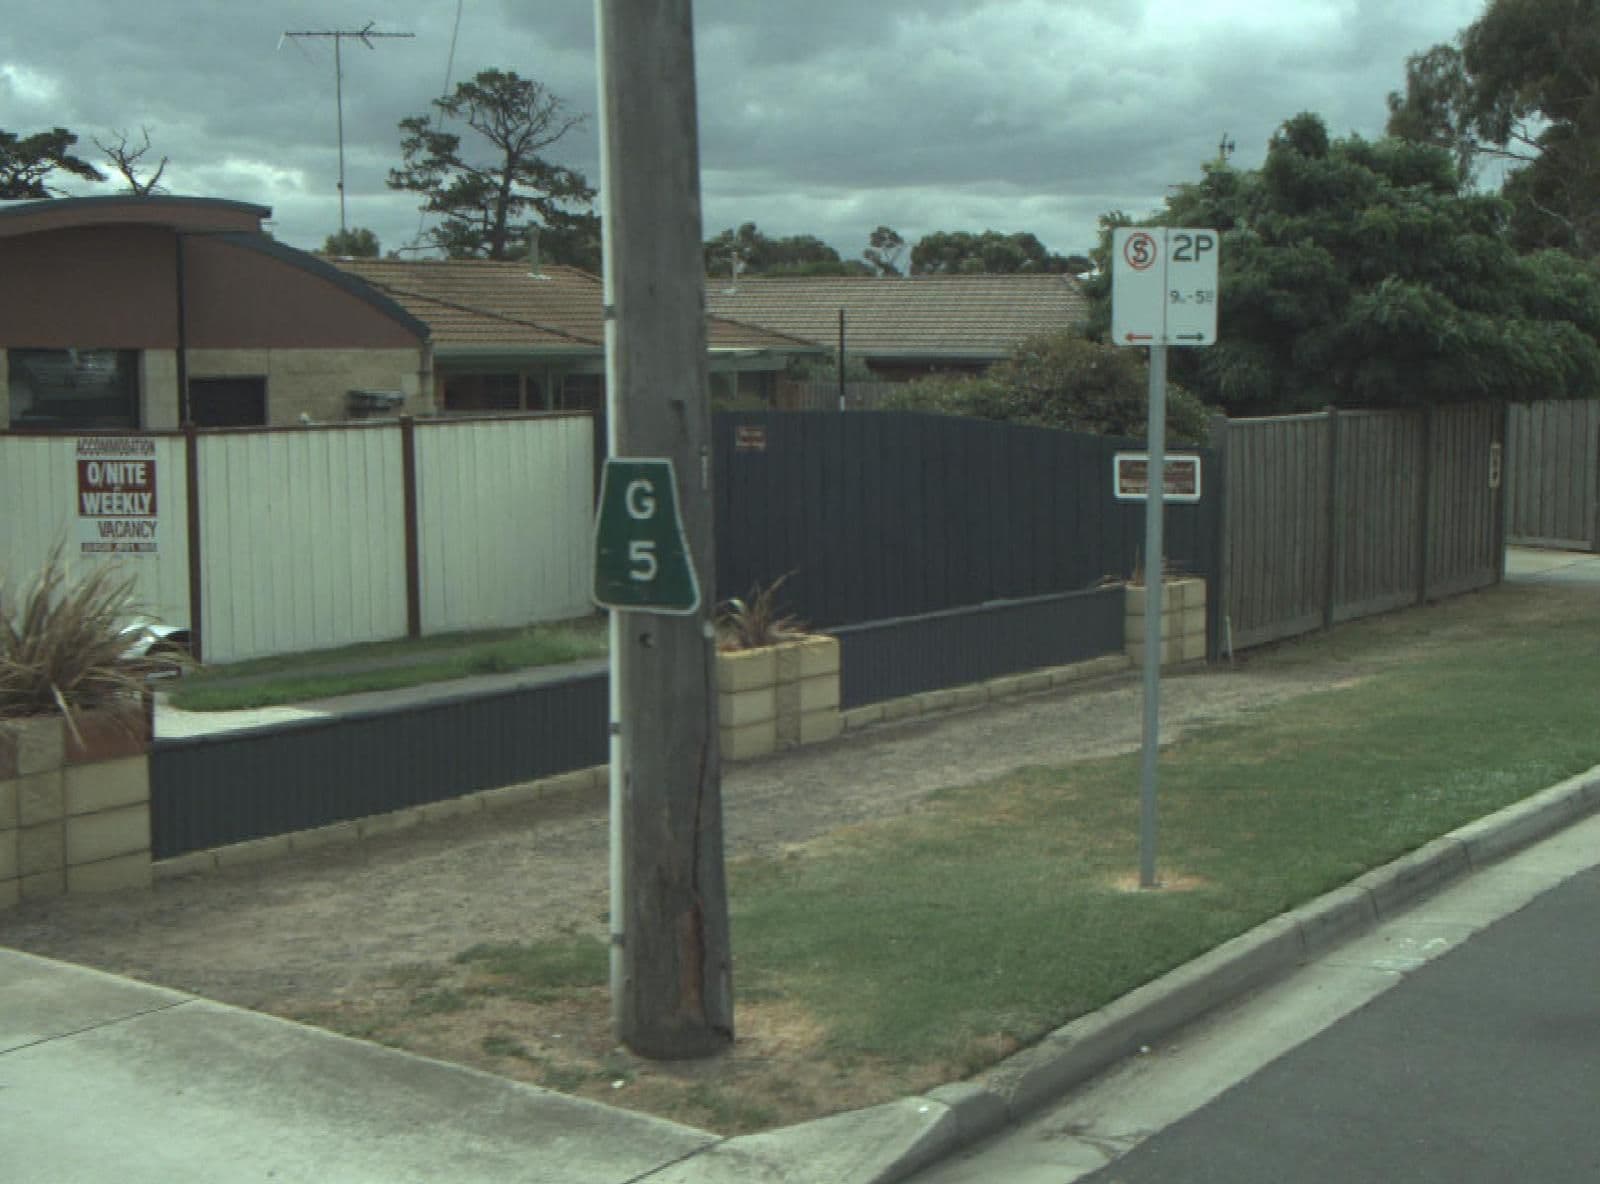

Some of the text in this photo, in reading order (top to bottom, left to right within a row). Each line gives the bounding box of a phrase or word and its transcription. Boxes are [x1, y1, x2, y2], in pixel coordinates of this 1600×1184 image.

[1173, 234, 1214, 261] 2P
[87, 461, 147, 487] O/NITE
[82, 492, 152, 515] WEEKLY
[626, 480, 656, 520] G
[98, 520, 157, 538] VACANCY
[629, 540, 658, 581] 5
